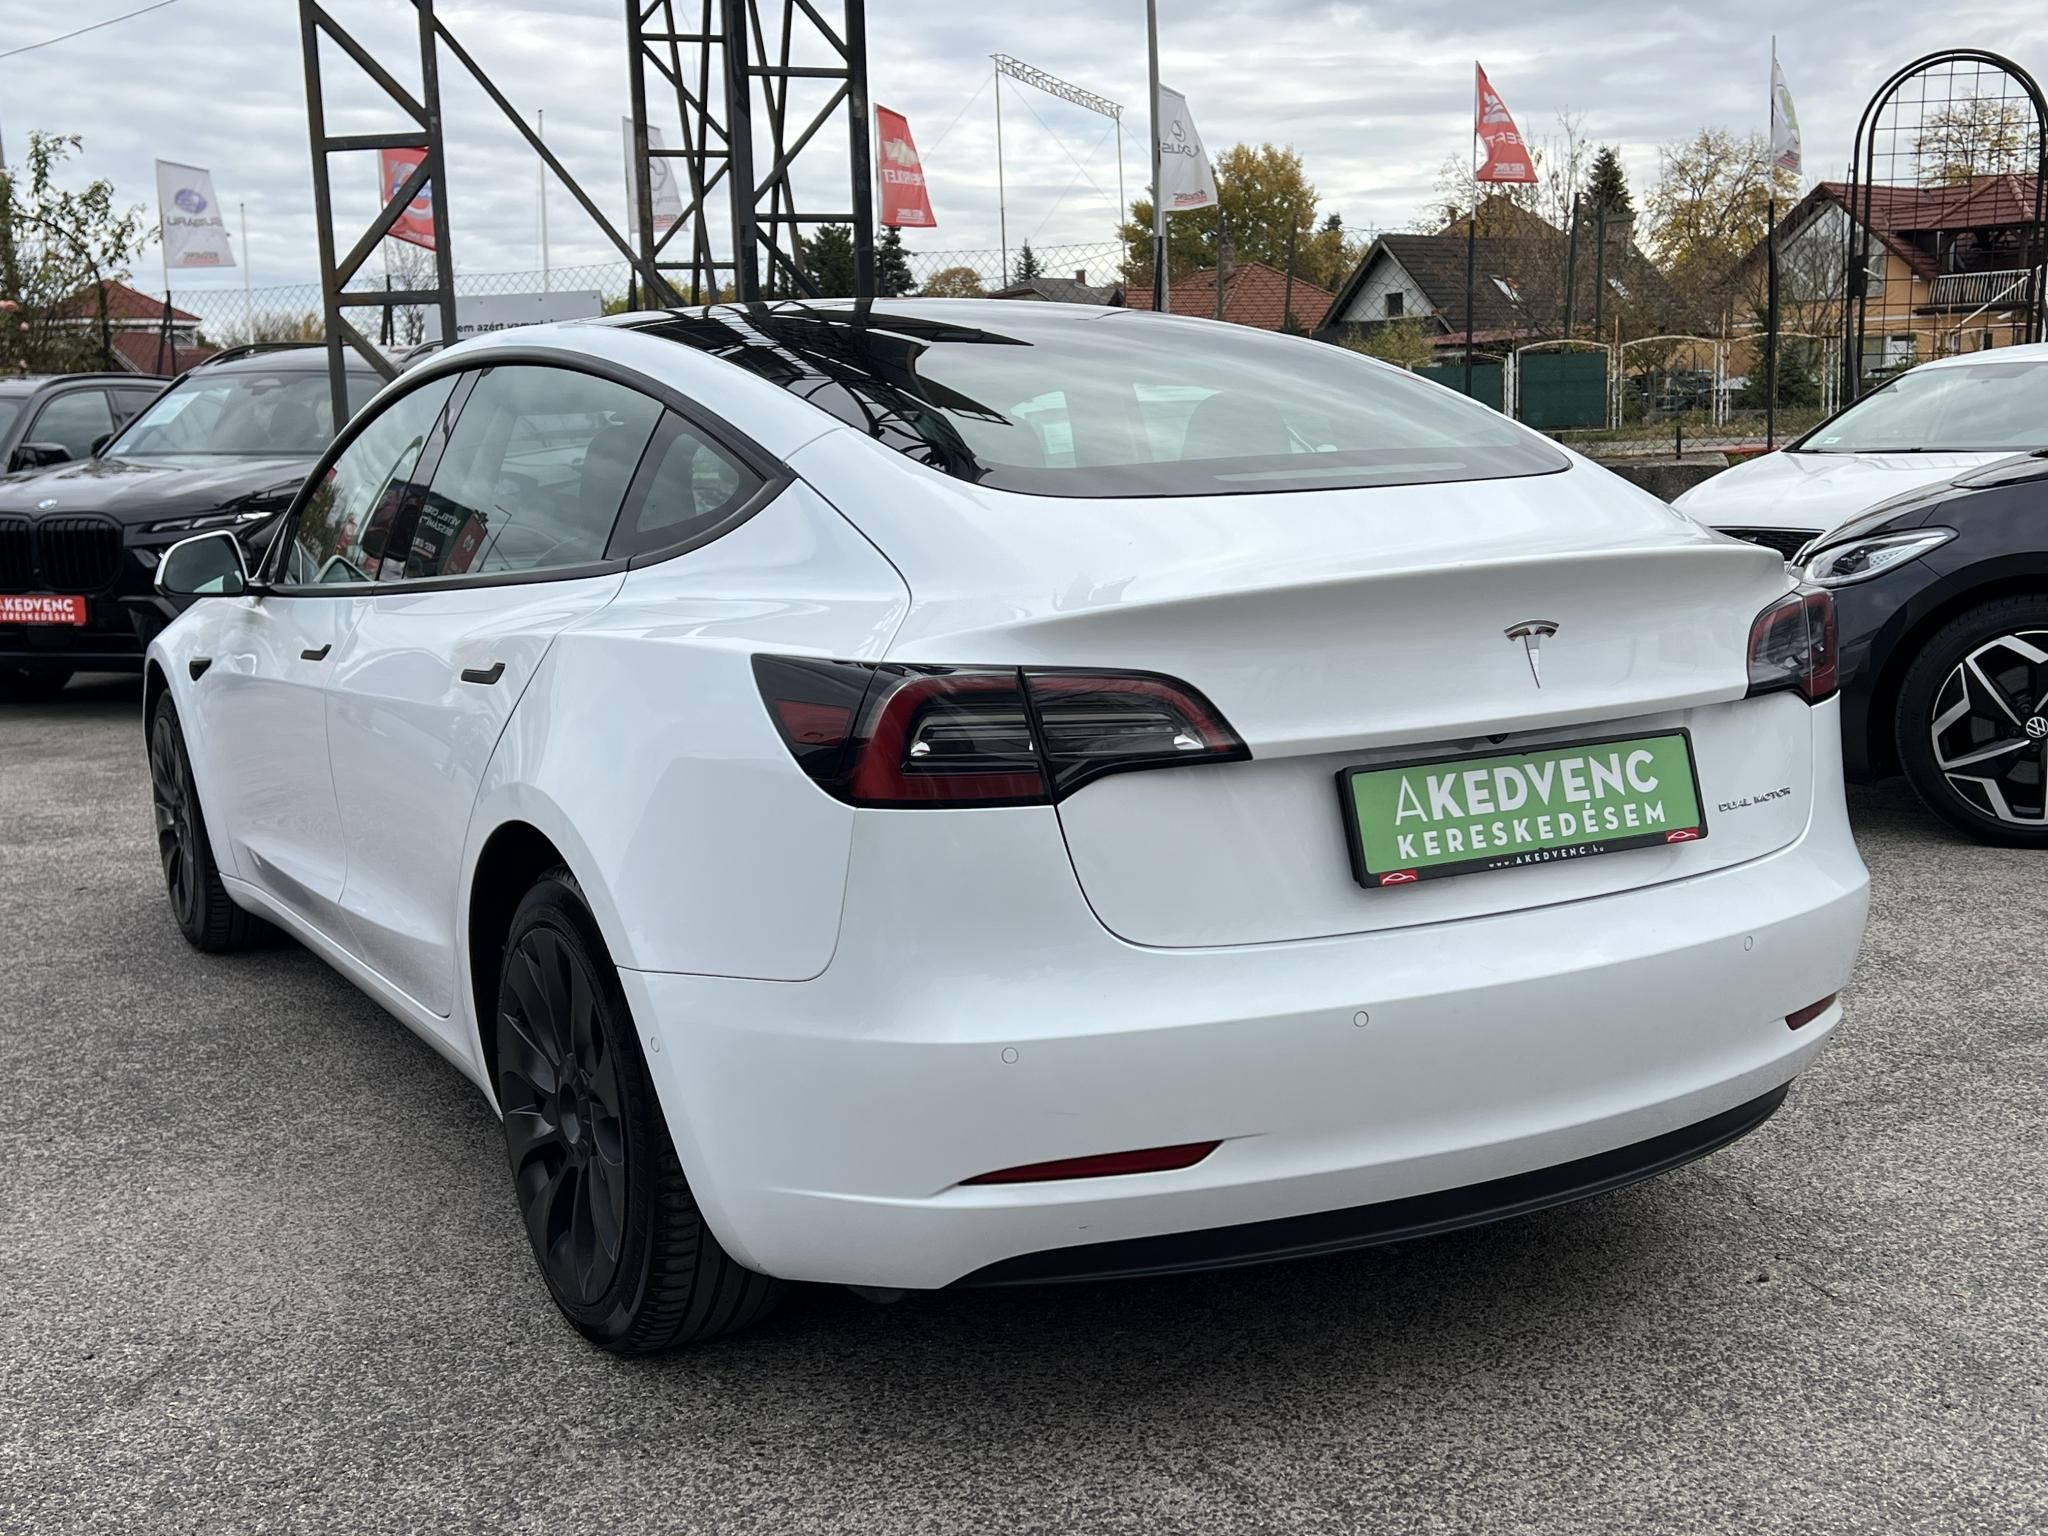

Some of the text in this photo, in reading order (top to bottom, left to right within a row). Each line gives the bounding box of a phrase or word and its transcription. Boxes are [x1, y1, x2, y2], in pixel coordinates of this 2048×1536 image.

[457, 323, 475, 333] em
[1395, 750, 1659, 826] AKEDVENC
[1718, 786, 1791, 813] DUAL MOTOR
[1397, 800, 1666, 860] KERESKEDÉSEM
